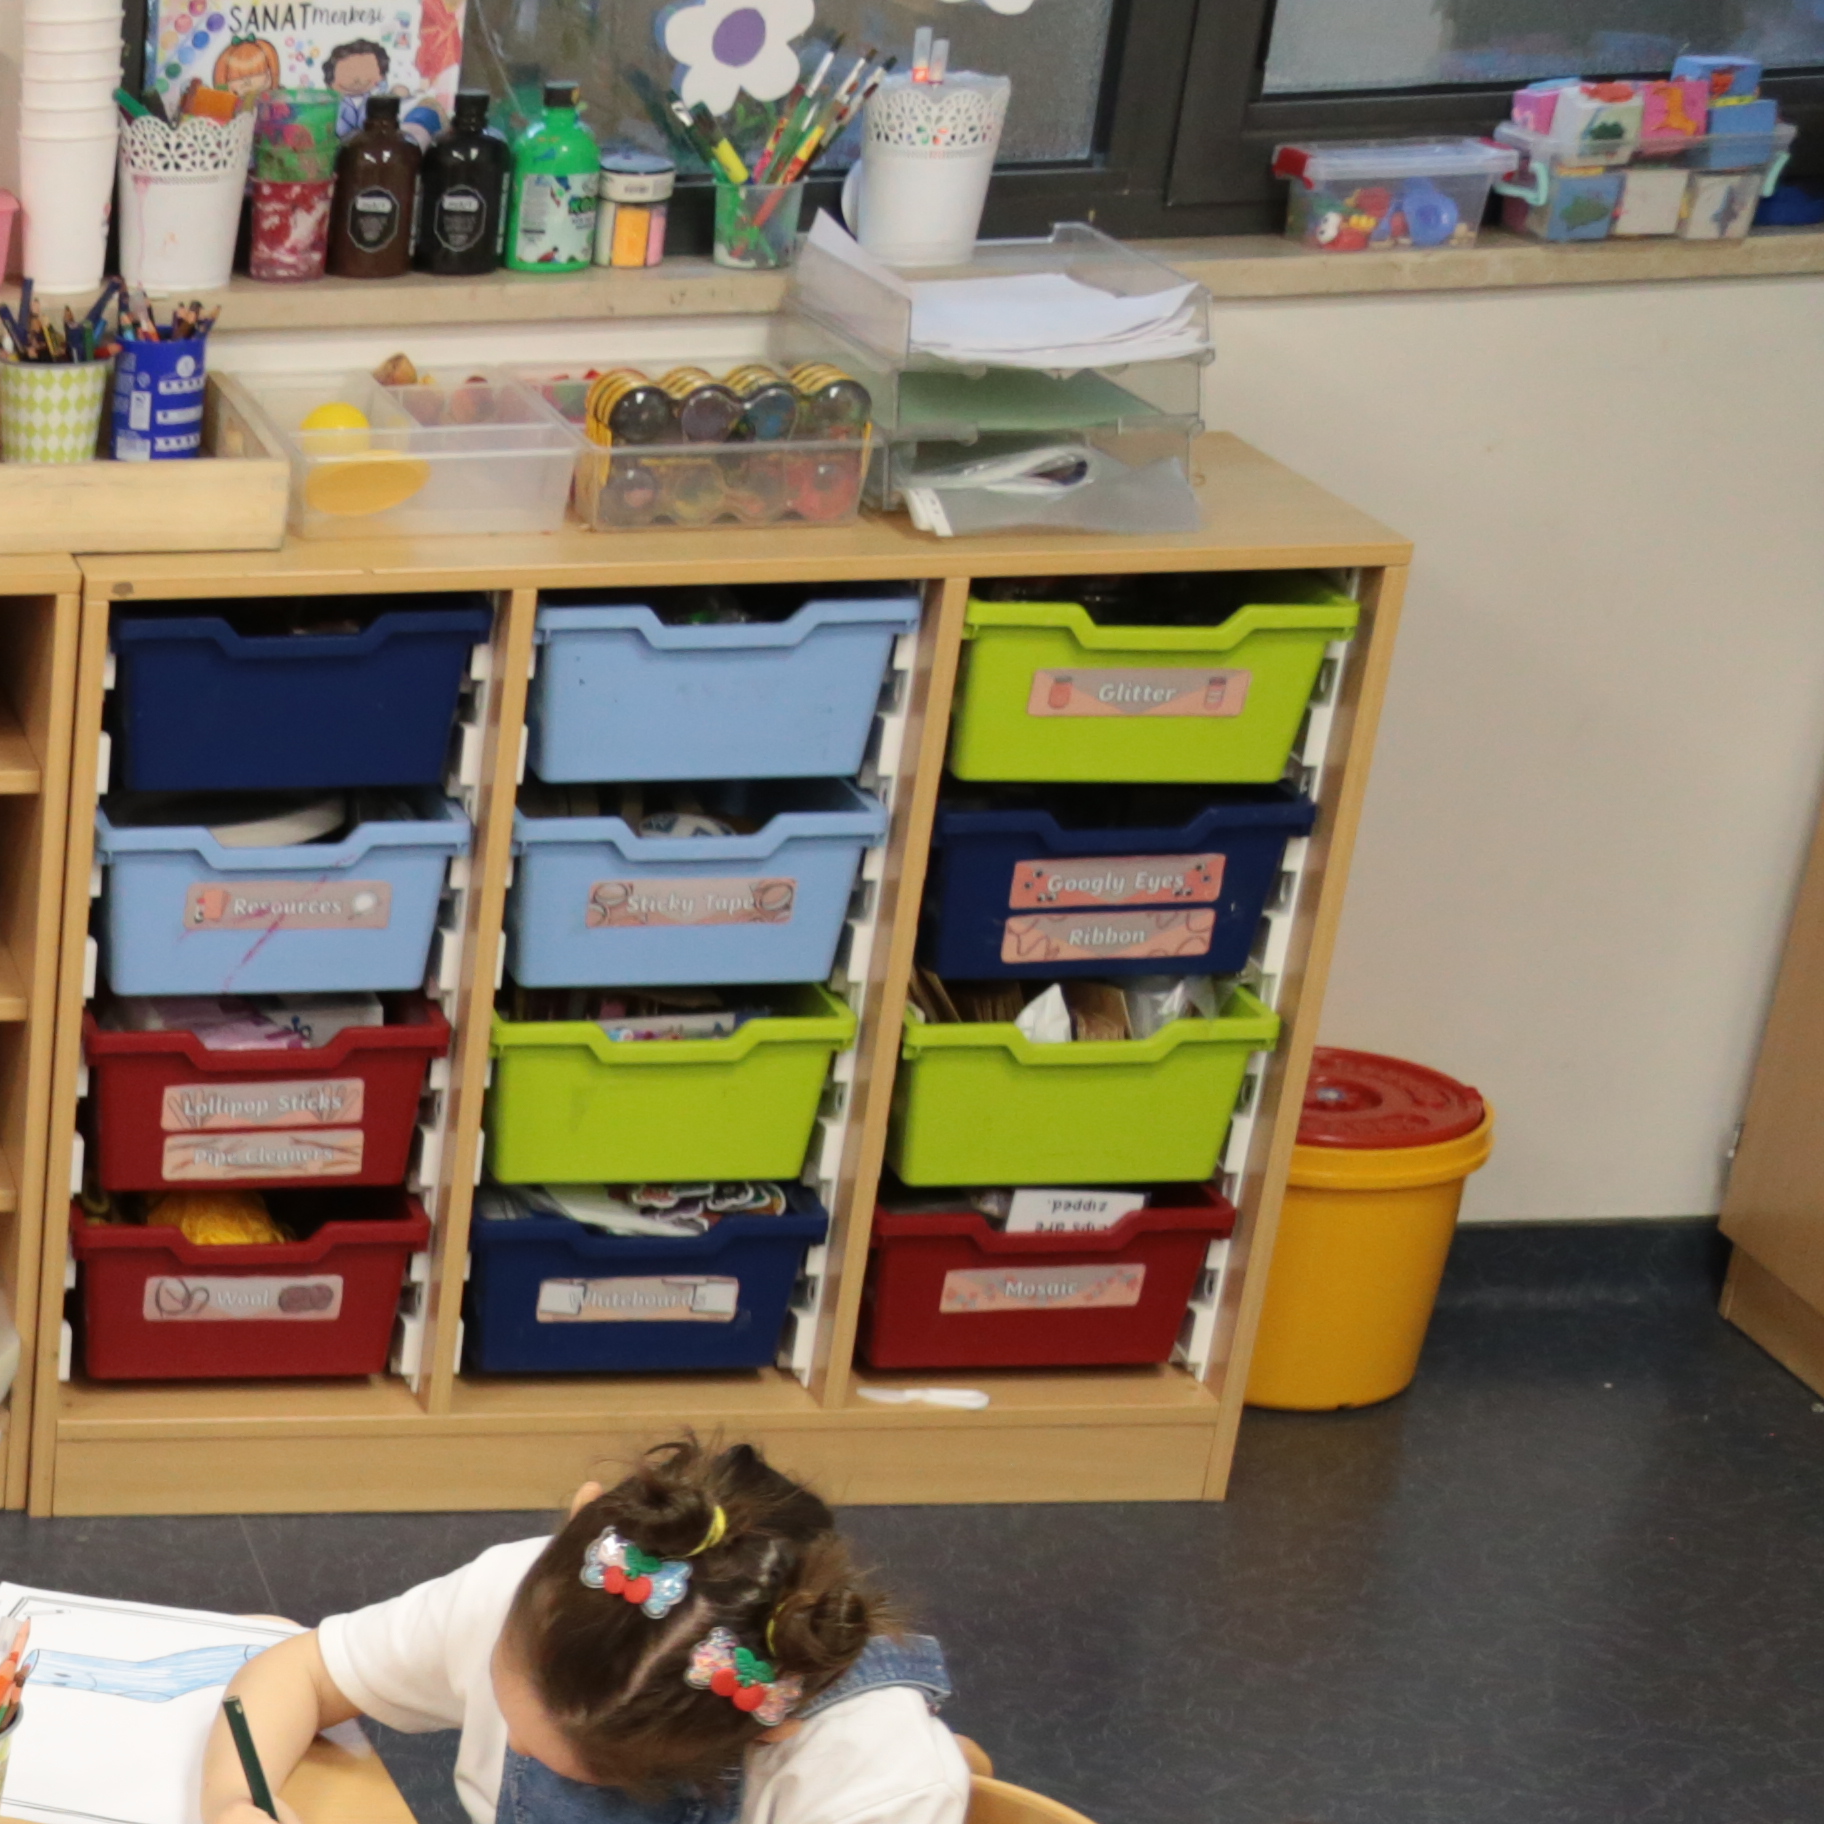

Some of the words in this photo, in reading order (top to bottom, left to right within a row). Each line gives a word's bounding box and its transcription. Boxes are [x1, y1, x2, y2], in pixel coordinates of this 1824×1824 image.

[229, 3, 312, 34] SANAT
[1098, 682, 1177, 702] Glitter
[1047, 871, 1125, 893] Googly
[1134, 870, 1185, 891] Eyes
[233, 898, 342, 916] Resources
[626, 893, 695, 916] Sticky
[706, 893, 755, 914] Tape
[1068, 927, 1146, 946] Ribbon
[184, 1095, 269, 1118] Lollipop
[277, 1093, 343, 1112] Sticks
[194, 1149, 237, 1168] Pipe
[245, 1146, 334, 1163] Cleaners
[217, 1289, 271, 1307] Wool
[1004, 1278, 1079, 1298] Mosaic
